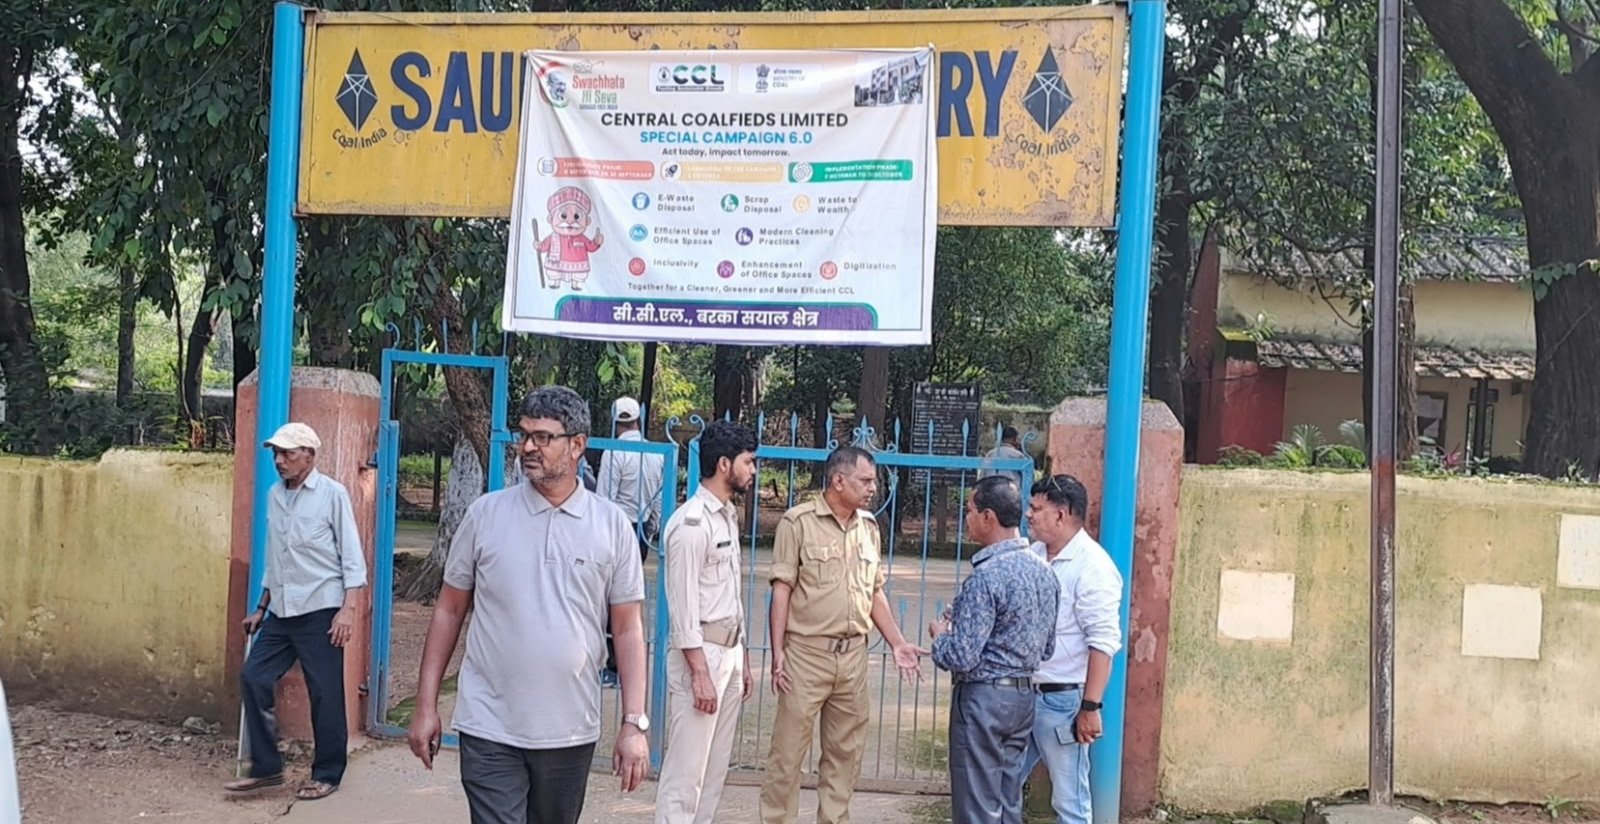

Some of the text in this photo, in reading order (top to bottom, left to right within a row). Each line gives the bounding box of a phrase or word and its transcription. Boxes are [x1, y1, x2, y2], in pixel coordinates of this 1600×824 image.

[672, 65, 725, 85] CCL
[572, 75, 625, 90] Swachhata
[390, 51, 523, 133] SAU
[594, 90, 618, 104] Seva
[936, 50, 1019, 138] RY
[601, 113, 848, 127] CENTRAL COALFIEDS LIMITED
[332, 127, 388, 149] Coal India
[640, 131, 813, 144] SPECIAL CAMPAIGN 6.0
[1015, 132, 1081, 156] Coal India
[662, 148, 790, 158] Act today, impact tomorrow.
[658, 194, 695, 202] E-Waste
[744, 196, 769, 205] Scrap
[817, 196, 858, 204] Waste to
[658, 204, 695, 213] Disposal
[744, 206, 782, 214] Disposal
[817, 206, 850, 214] Wealth
[654, 227, 721, 236] Efficient Use of
[759, 228, 834, 237] Modern Cleaning
[653, 236, 713, 247] Office Spaces
[759, 237, 800, 246] Practices
[653, 259, 699, 269] Inclusivity
[741, 260, 803, 269] Enhancement
[843, 261, 897, 271] Digitization
[740, 270, 812, 280] of Office Spaces
[628, 283, 664, 293] Together
[666, 283, 678, 292] for
[687, 284, 721, 293] Cleaner,
[723, 285, 757, 293] Greener
[759, 286, 774, 294] and
[777, 286, 798, 294] More
[801, 286, 836, 295] Efficient
[838, 286, 855, 295] CCL
[612, 301, 820, 327] सी.सी.एल., बरका सयाल क्षेत्र
